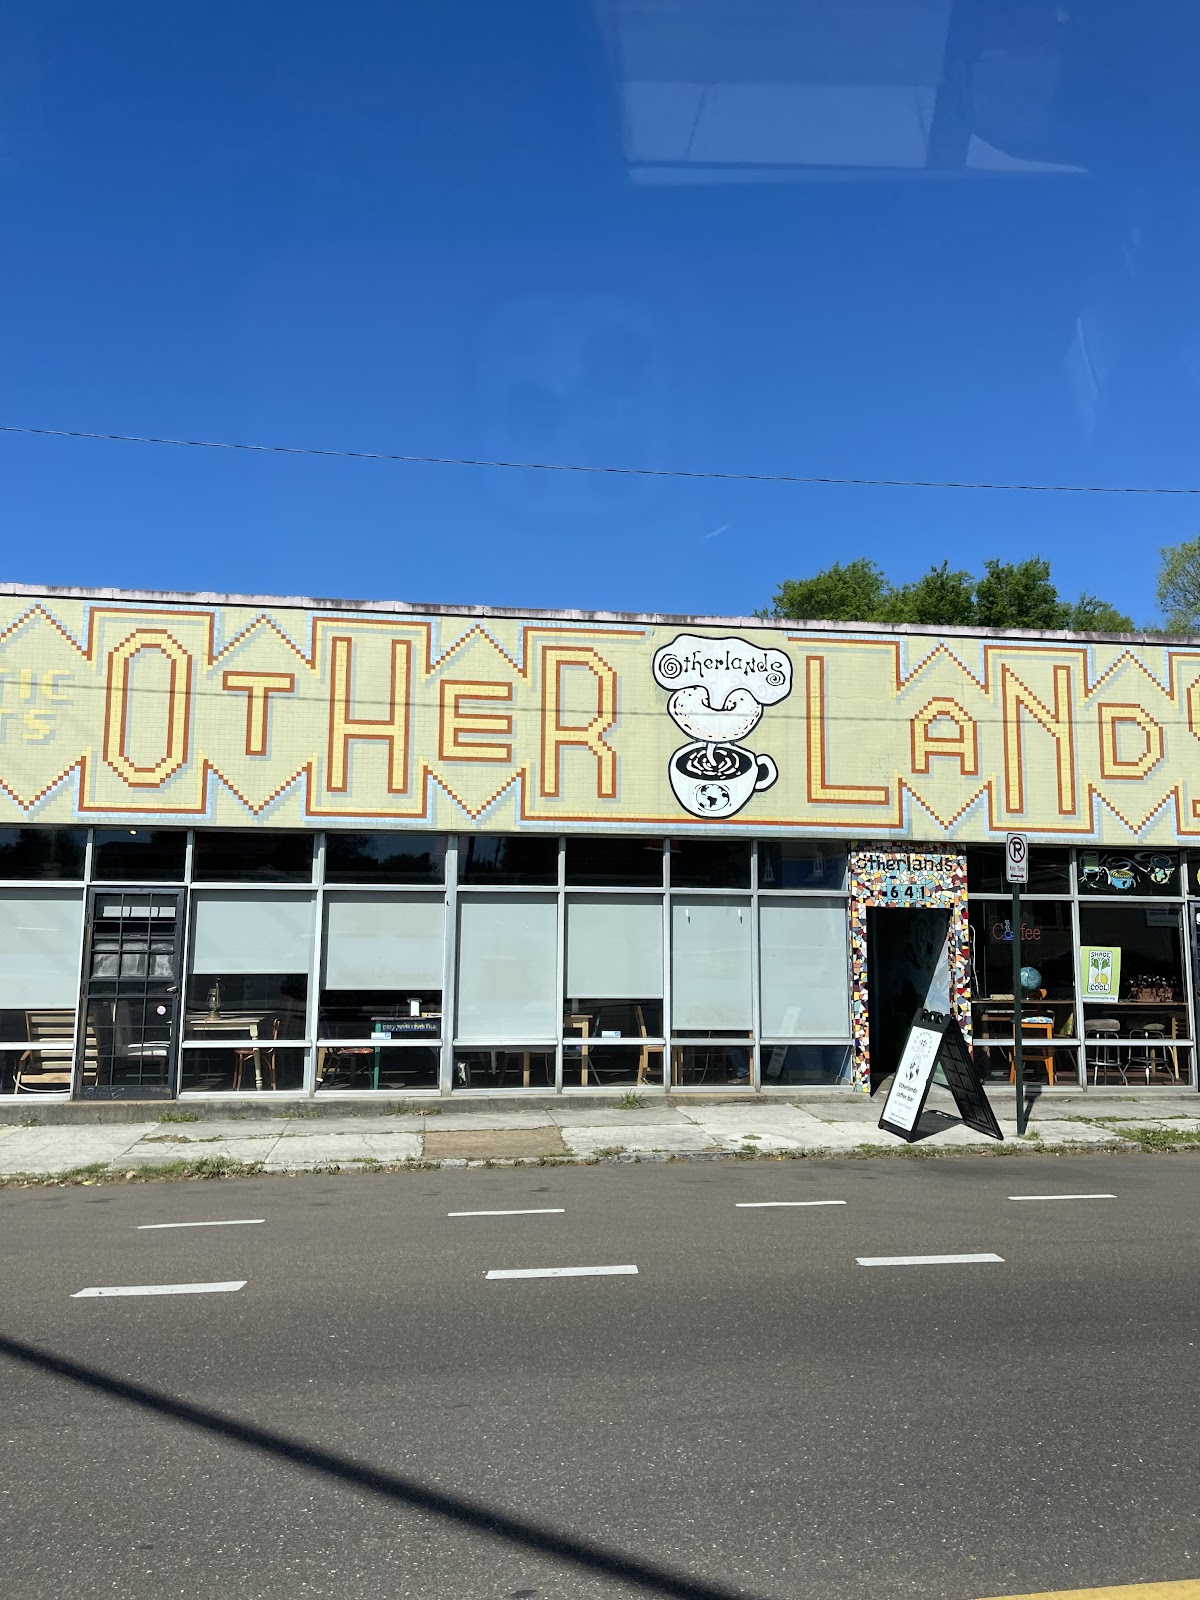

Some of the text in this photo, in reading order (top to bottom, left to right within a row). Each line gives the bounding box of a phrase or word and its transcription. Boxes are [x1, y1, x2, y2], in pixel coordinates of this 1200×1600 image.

[103, 628, 618, 799] OTHER
[890, 885, 926, 899] 641
[992, 922, 1041, 940] Cfee
